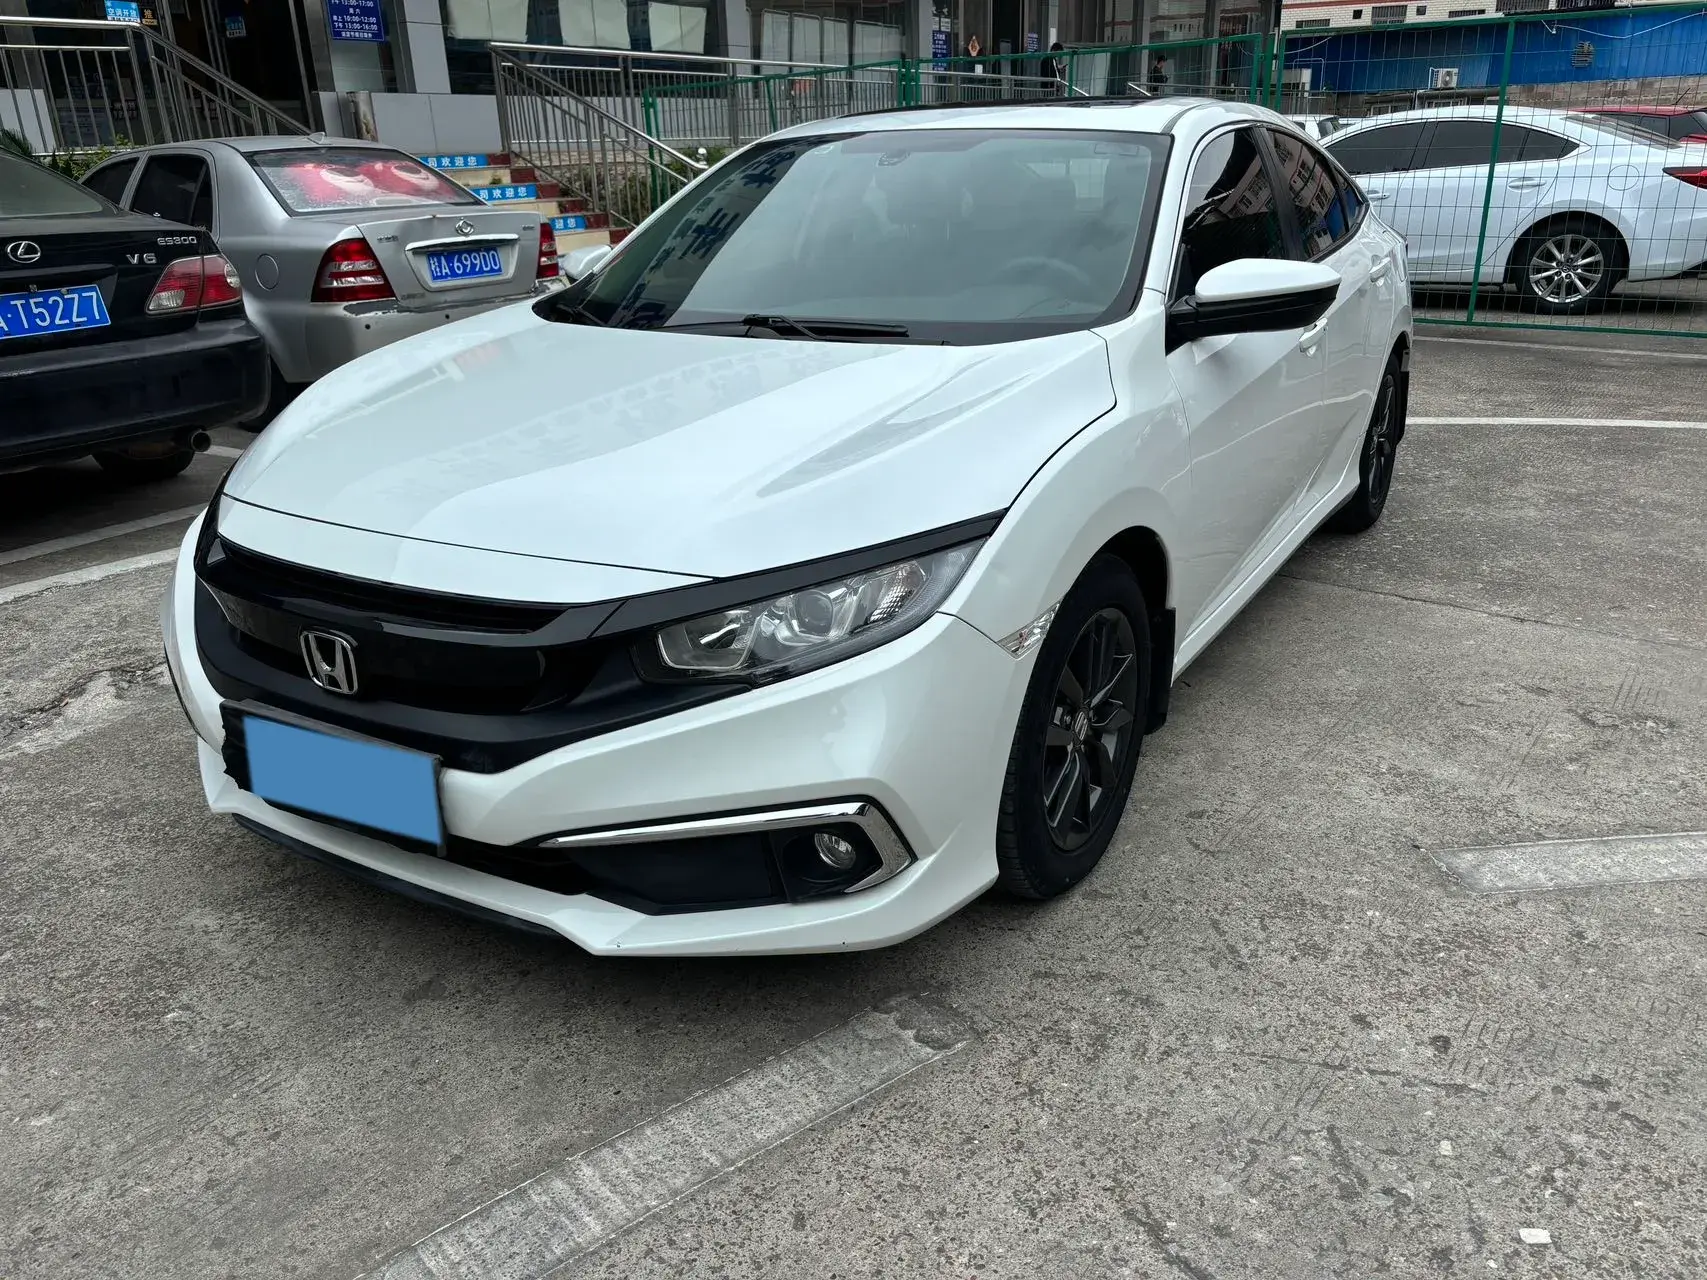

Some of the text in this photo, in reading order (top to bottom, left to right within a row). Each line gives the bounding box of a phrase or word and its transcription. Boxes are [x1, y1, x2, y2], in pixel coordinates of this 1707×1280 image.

[107, 8, 137, 17] 空调开放
[144, 9, 153, 18] 推
[344, 15, 376, 23] 10:00-12:00
[427, 156, 478, 167] 司欢迎您
[479, 187, 528, 200] 司欢迎您
[555, 217, 576, 229] 迎您
[157, 236, 197, 246] ES300
